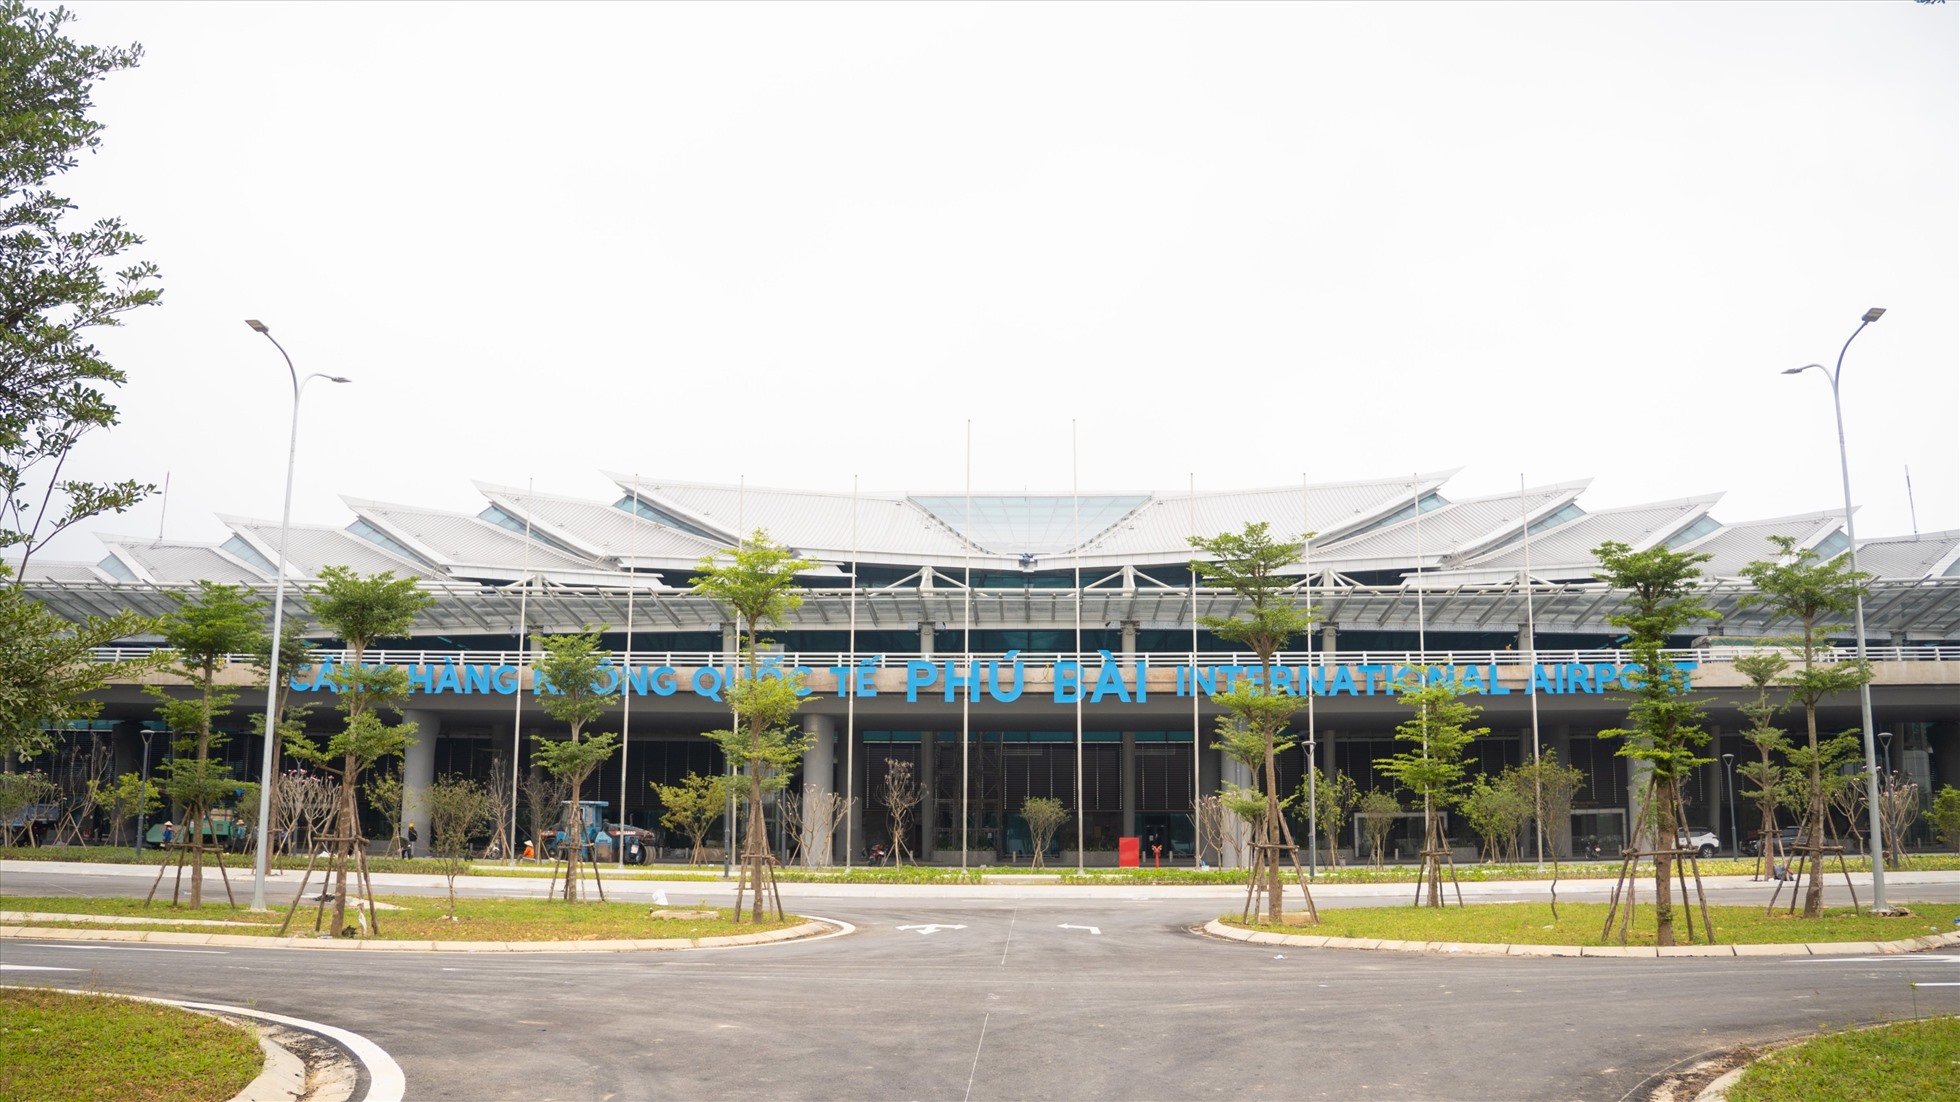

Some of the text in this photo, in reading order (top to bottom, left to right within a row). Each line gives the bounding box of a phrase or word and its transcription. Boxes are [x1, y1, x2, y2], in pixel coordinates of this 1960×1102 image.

[289, 655, 391, 692] CẢ
[408, 656, 518, 695] HÀNG
[533, 657, 678, 697] KÔNG
[829, 655, 881, 698] TẾ
[907, 649, 1024, 703] PHÚ
[1053, 649, 1147, 704] BÀI
[1176, 664, 1511, 697] INTERNATIONAL
